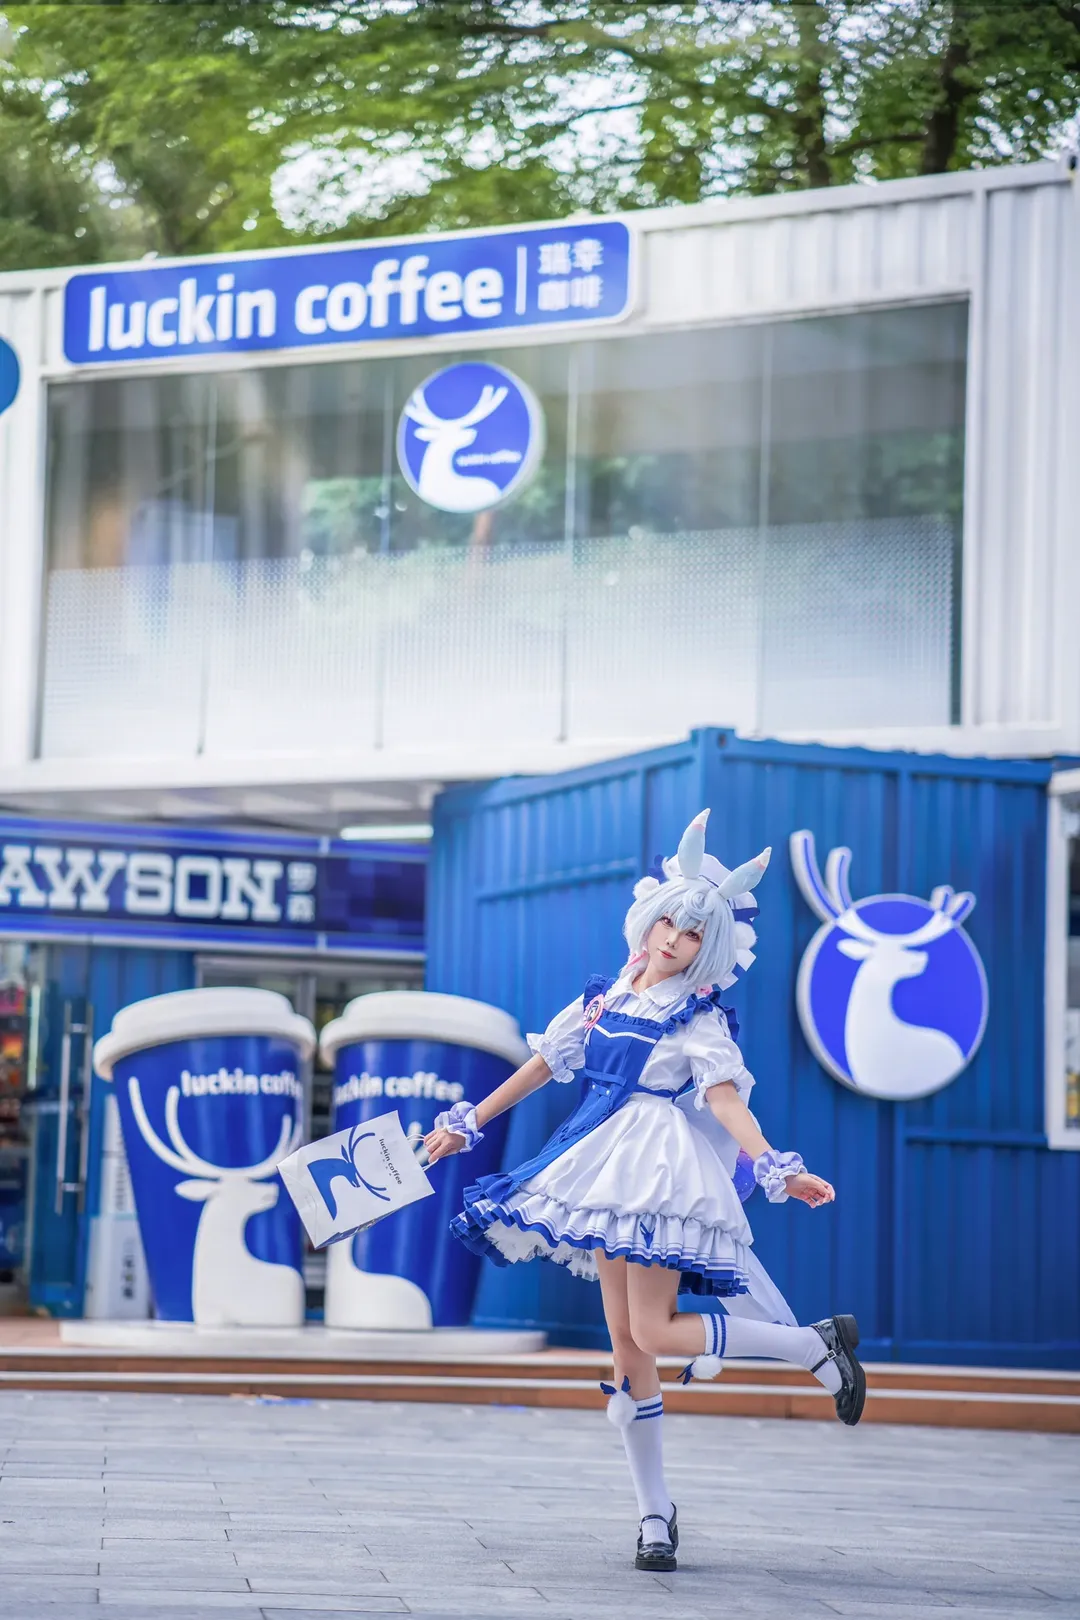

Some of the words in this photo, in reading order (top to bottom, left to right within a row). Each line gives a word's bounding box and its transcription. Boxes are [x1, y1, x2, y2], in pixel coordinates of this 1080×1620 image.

[88, 273, 277, 352] luckin
[294, 255, 504, 335] coffee
[0, 844, 283, 922] AWSON
[180, 1067, 259, 1097] luckin
[384, 1071, 464, 1102] coffee
[379, 1138, 391, 1162] luckin
[387, 1162, 403, 1185] coffee
